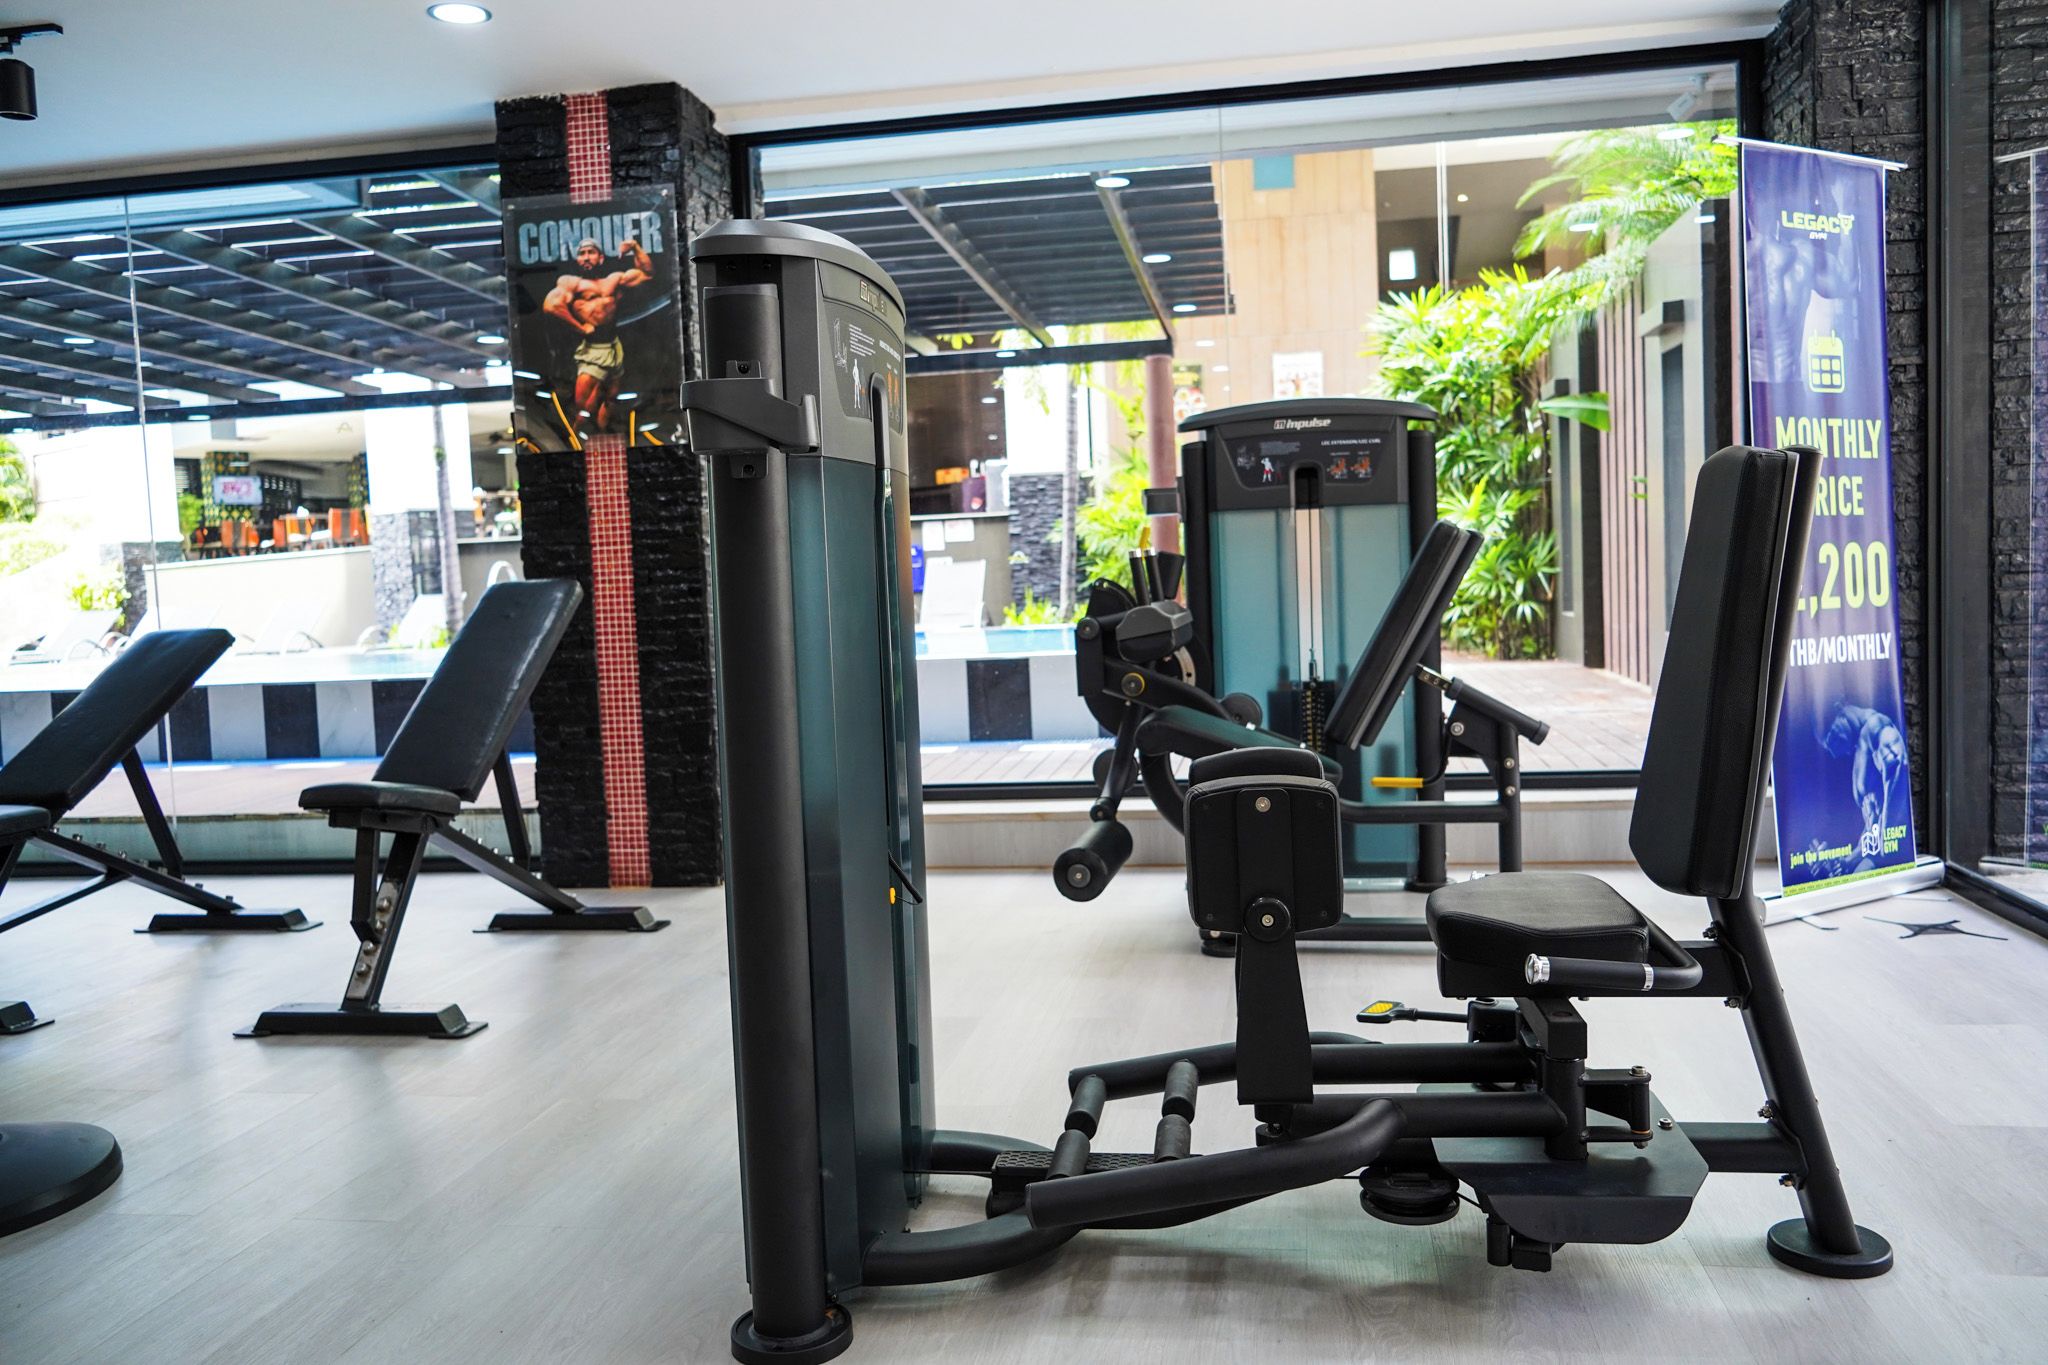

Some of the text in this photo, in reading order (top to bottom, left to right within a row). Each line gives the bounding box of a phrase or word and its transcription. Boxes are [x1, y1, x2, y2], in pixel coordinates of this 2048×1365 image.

[518, 211, 663, 265] CONQUER
[1781, 210, 1855, 235] LEGACY
[1809, 231, 1828, 241] GYM
[1775, 416, 1882, 459] MONTHLY
[1815, 475, 1865, 517] RICE
[1797, 541, 1890, 619] ,200
[1789, 632, 1892, 667] THB/MONTHLY
[1883, 825, 1907, 840] LEGACY
[1883, 839, 1899, 854] GYM
[1790, 843, 1853, 870] join the movement
